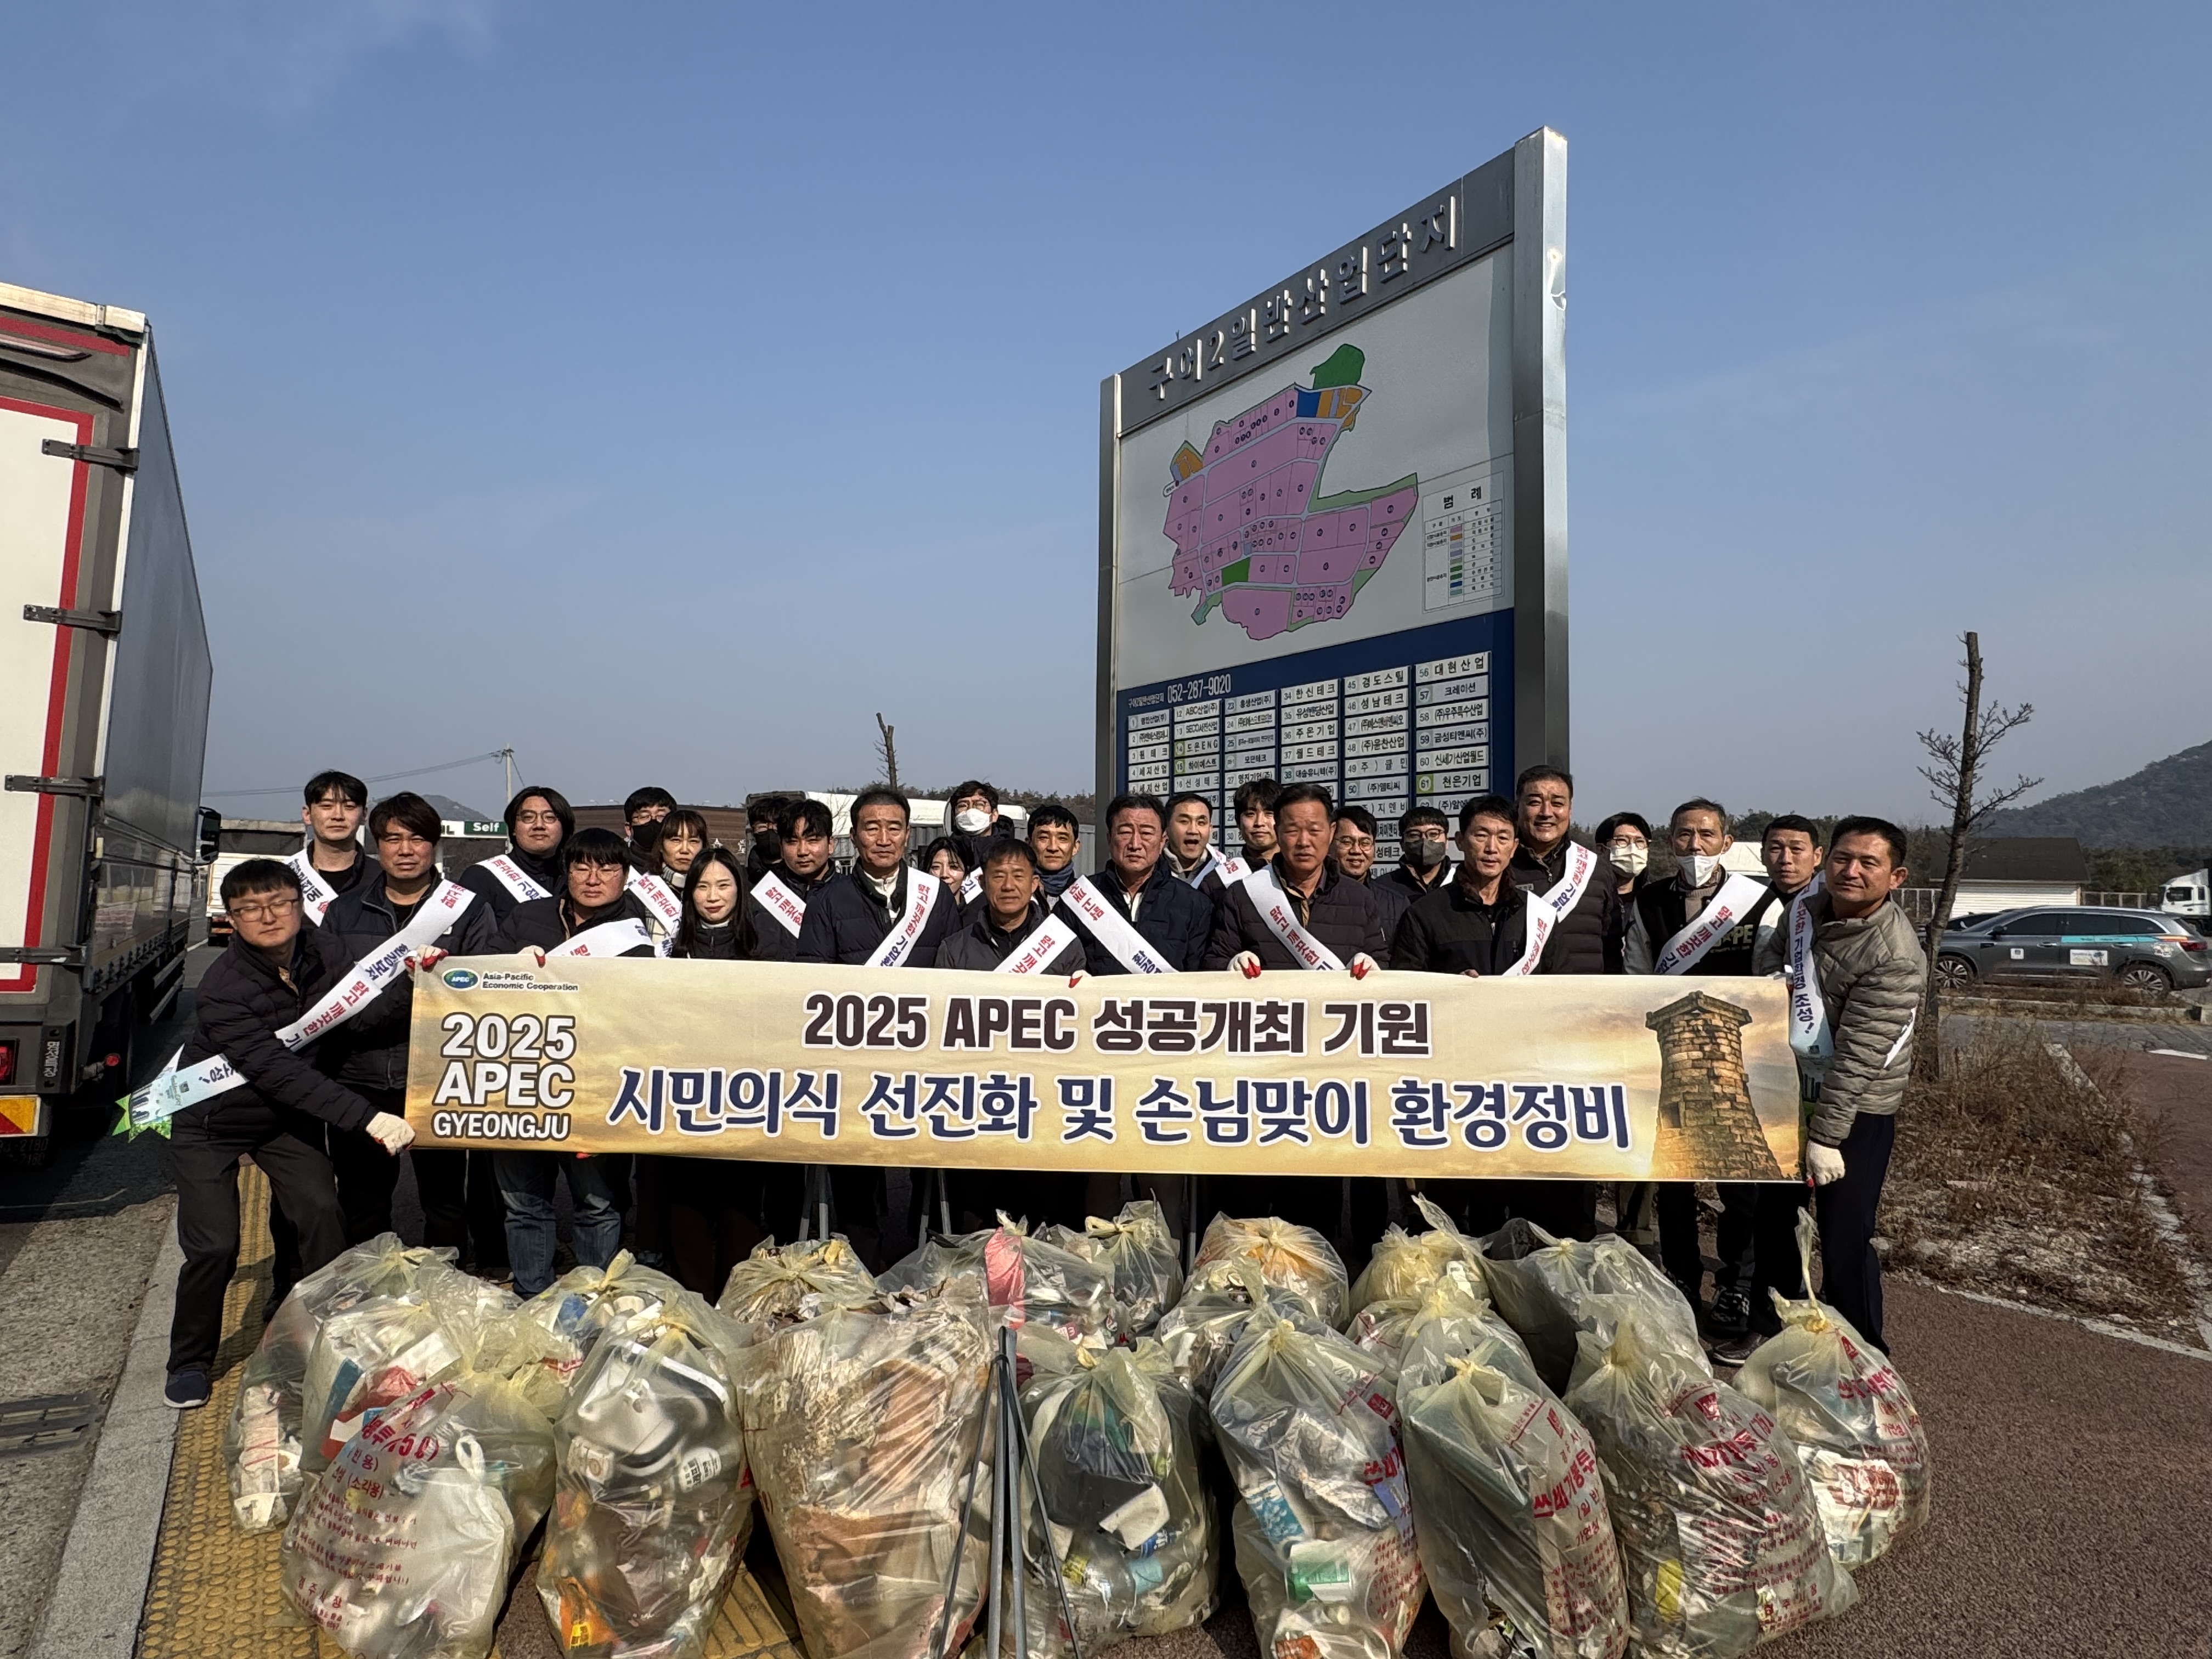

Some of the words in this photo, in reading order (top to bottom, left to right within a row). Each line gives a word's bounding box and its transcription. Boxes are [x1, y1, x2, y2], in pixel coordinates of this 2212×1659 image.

[1149, 196, 1455, 400] 구어2일반산업단지
[1167, 674, 1232, 704] 052-287-9020
[1296, 684, 1335, 699] 한신테크
[1361, 693, 1404, 710] 성남테크
[473, 822, 500, 832] Self
[1285, 928, 1321, 966] 깨끗한
[1675, 926, 1713, 959] 깨끗한
[342, 980, 370, 1007] 맑고
[482, 981, 524, 990] Economic
[527, 983, 578, 991] Cooperation
[303, 1001, 346, 1037] 깨끗한
[804, 995, 927, 1048] 2025
[944, 997, 1075, 1049] APEC
[1093, 999, 1304, 1053] 성공개최
[1324, 1002, 1429, 1054] 기원
[441, 1013, 576, 1060] 2025
[432, 1060, 574, 1109] APEC
[432, 1111, 572, 1140] GYEONGJU
[609, 1069, 837, 1136] 시민의식
[862, 1074, 1037, 1139] 선진화
[1057, 1078, 1114, 1142] 및
[1136, 1077, 1368, 1145] 손님맞이
[1391, 1079, 1629, 1150] 환경정비
